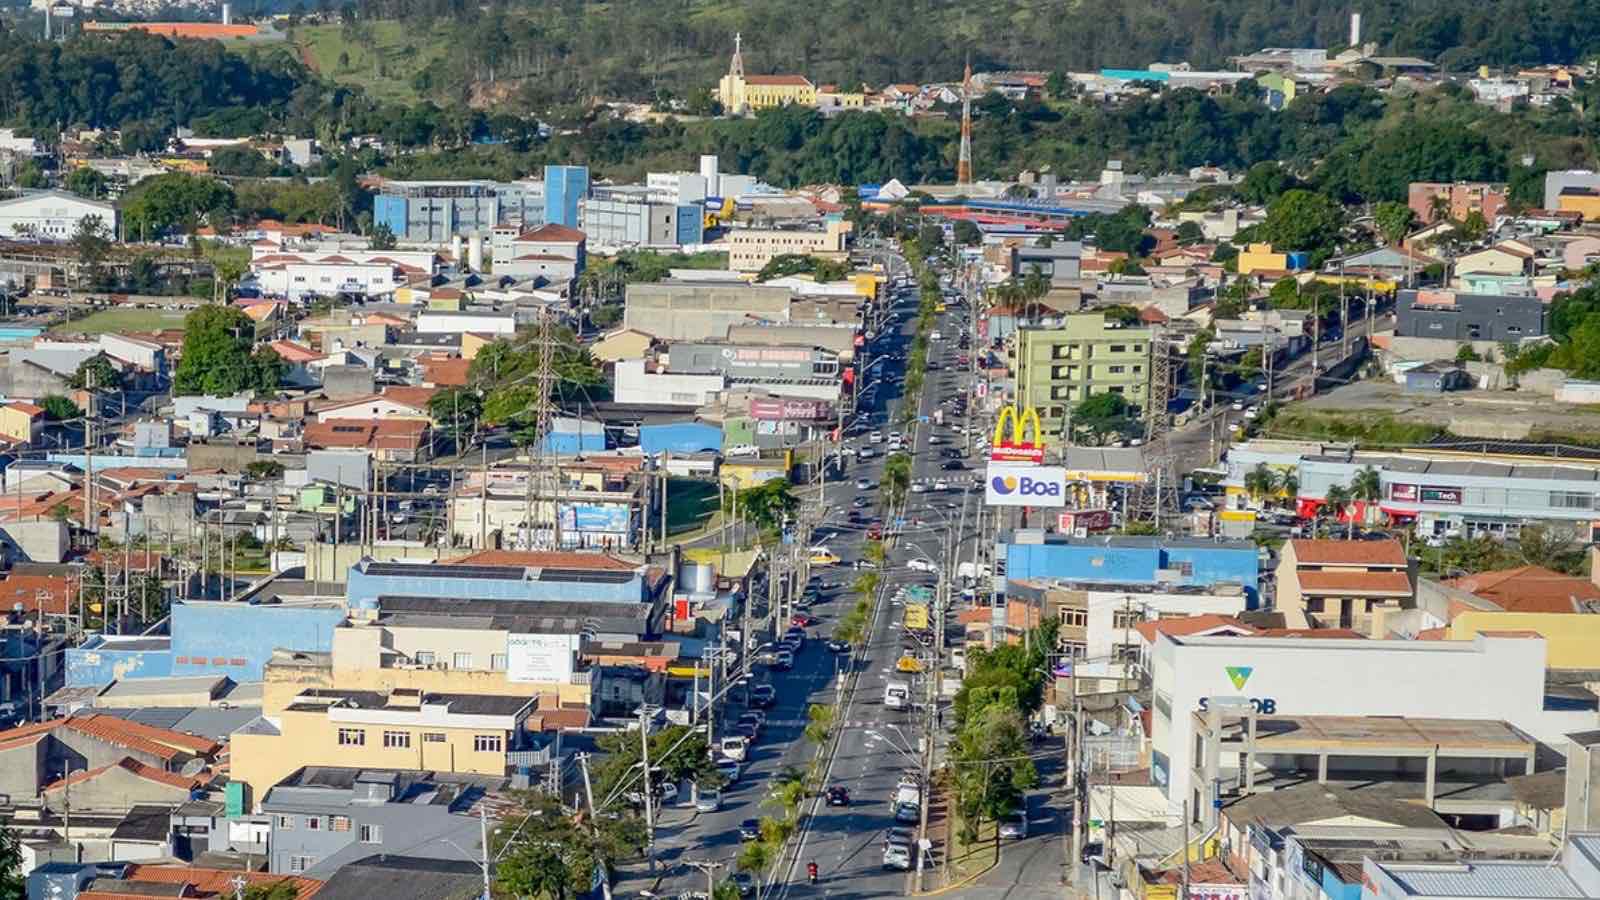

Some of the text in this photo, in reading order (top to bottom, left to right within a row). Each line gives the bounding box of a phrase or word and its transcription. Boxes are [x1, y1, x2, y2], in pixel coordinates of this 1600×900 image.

[992, 447, 1042, 457] McDonald's
[1020, 477, 1060, 496] Boa
[1199, 697, 1277, 715] SOB
